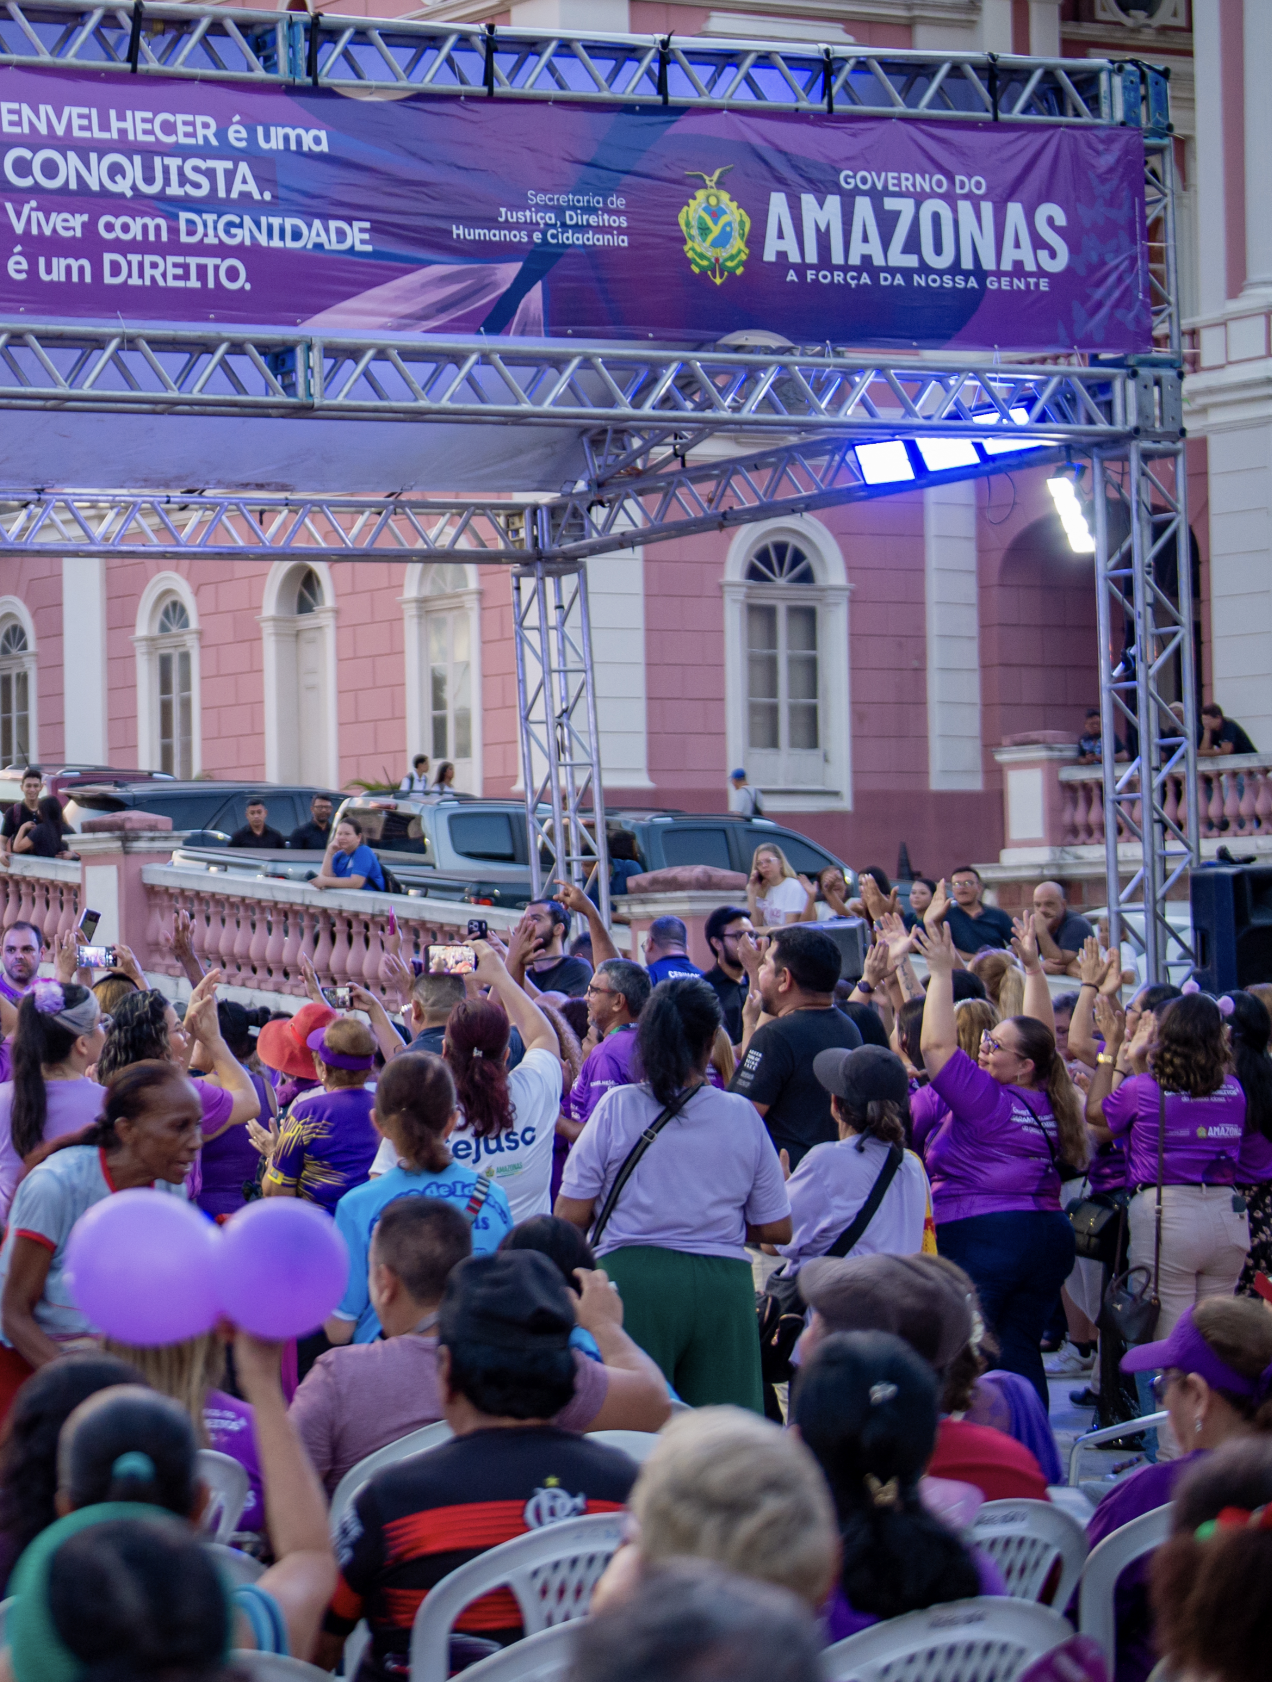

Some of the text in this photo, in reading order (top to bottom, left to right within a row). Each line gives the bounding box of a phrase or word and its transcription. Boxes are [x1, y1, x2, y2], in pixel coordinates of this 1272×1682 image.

[0, 101, 329, 153] ENVELHECER é uma
[3, 147, 272, 200] CONQUISTA.
[839, 169, 987, 195] GOVERNO DO
[498, 207, 628, 228] Justiça, Direitos
[527, 190, 626, 209] Secretaria de
[5, 200, 373, 251] Viver com DIGNIDADE
[452, 224, 629, 247] Humanos e Cidadania
[762, 191, 1070, 273] AMAZONAS
[7, 245, 251, 290] é um DIREITO.
[786, 269, 1050, 291] A FORÇA DA NOSSA GENTE
[445, 1126, 537, 1165] ejusc
